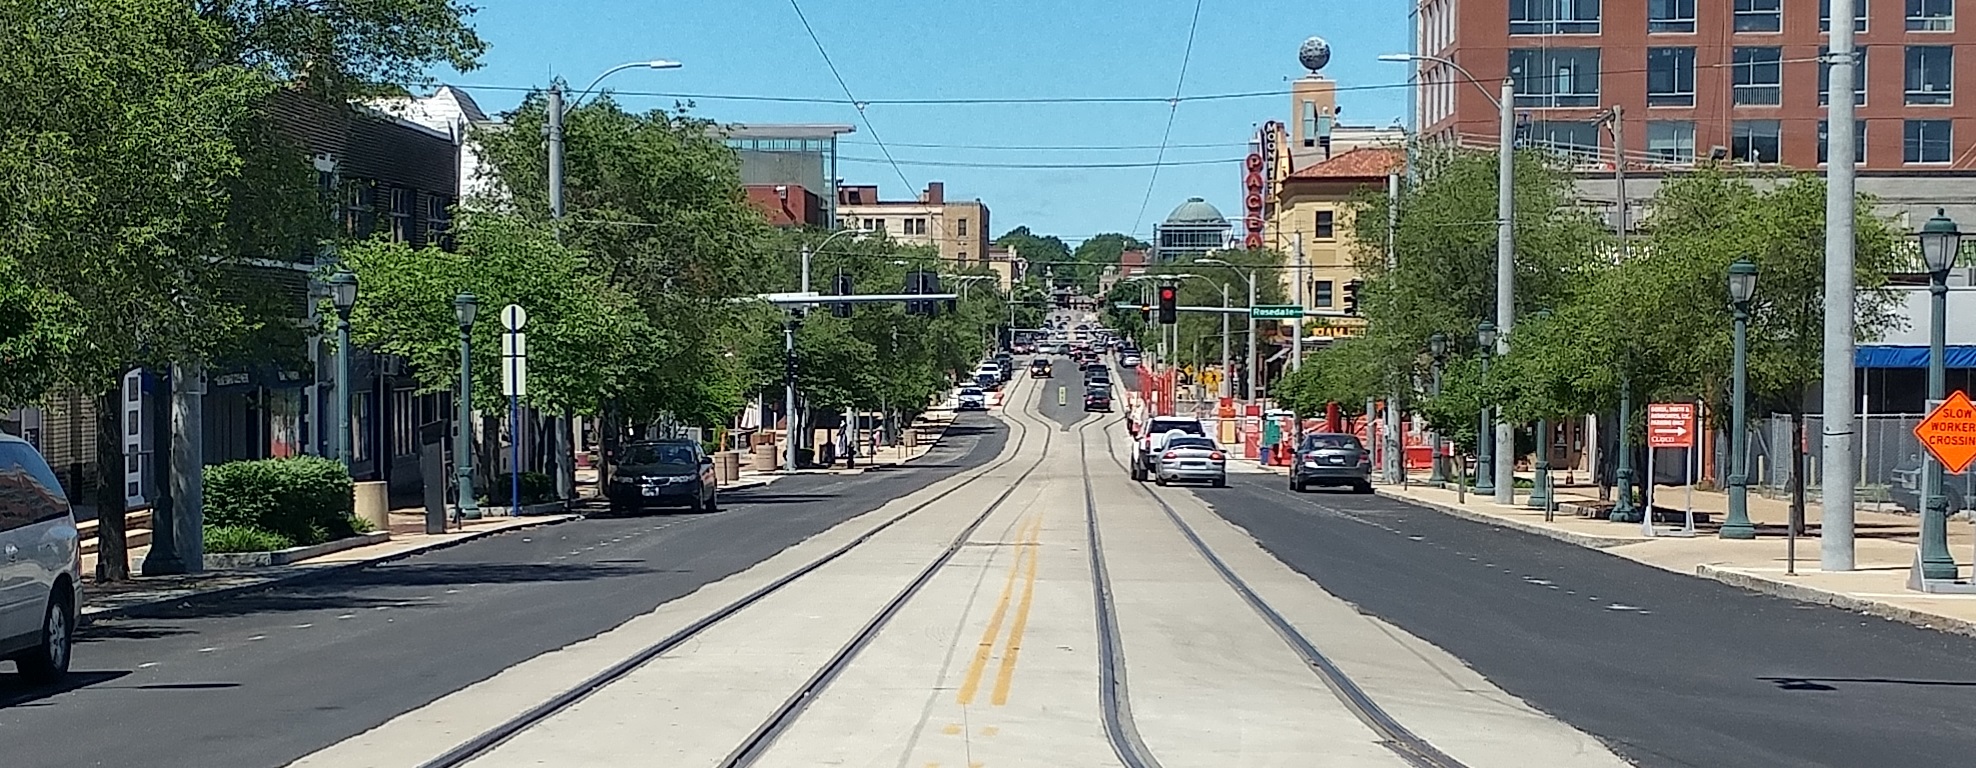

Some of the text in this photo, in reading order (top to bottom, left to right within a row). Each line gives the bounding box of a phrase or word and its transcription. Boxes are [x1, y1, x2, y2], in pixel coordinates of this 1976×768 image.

[1266, 123, 1277, 198] MOON
[1253, 308, 1294, 316] Rosedale
[1943, 409, 1972, 418] SLOW
[1931, 422, 1976, 432] WORKER
